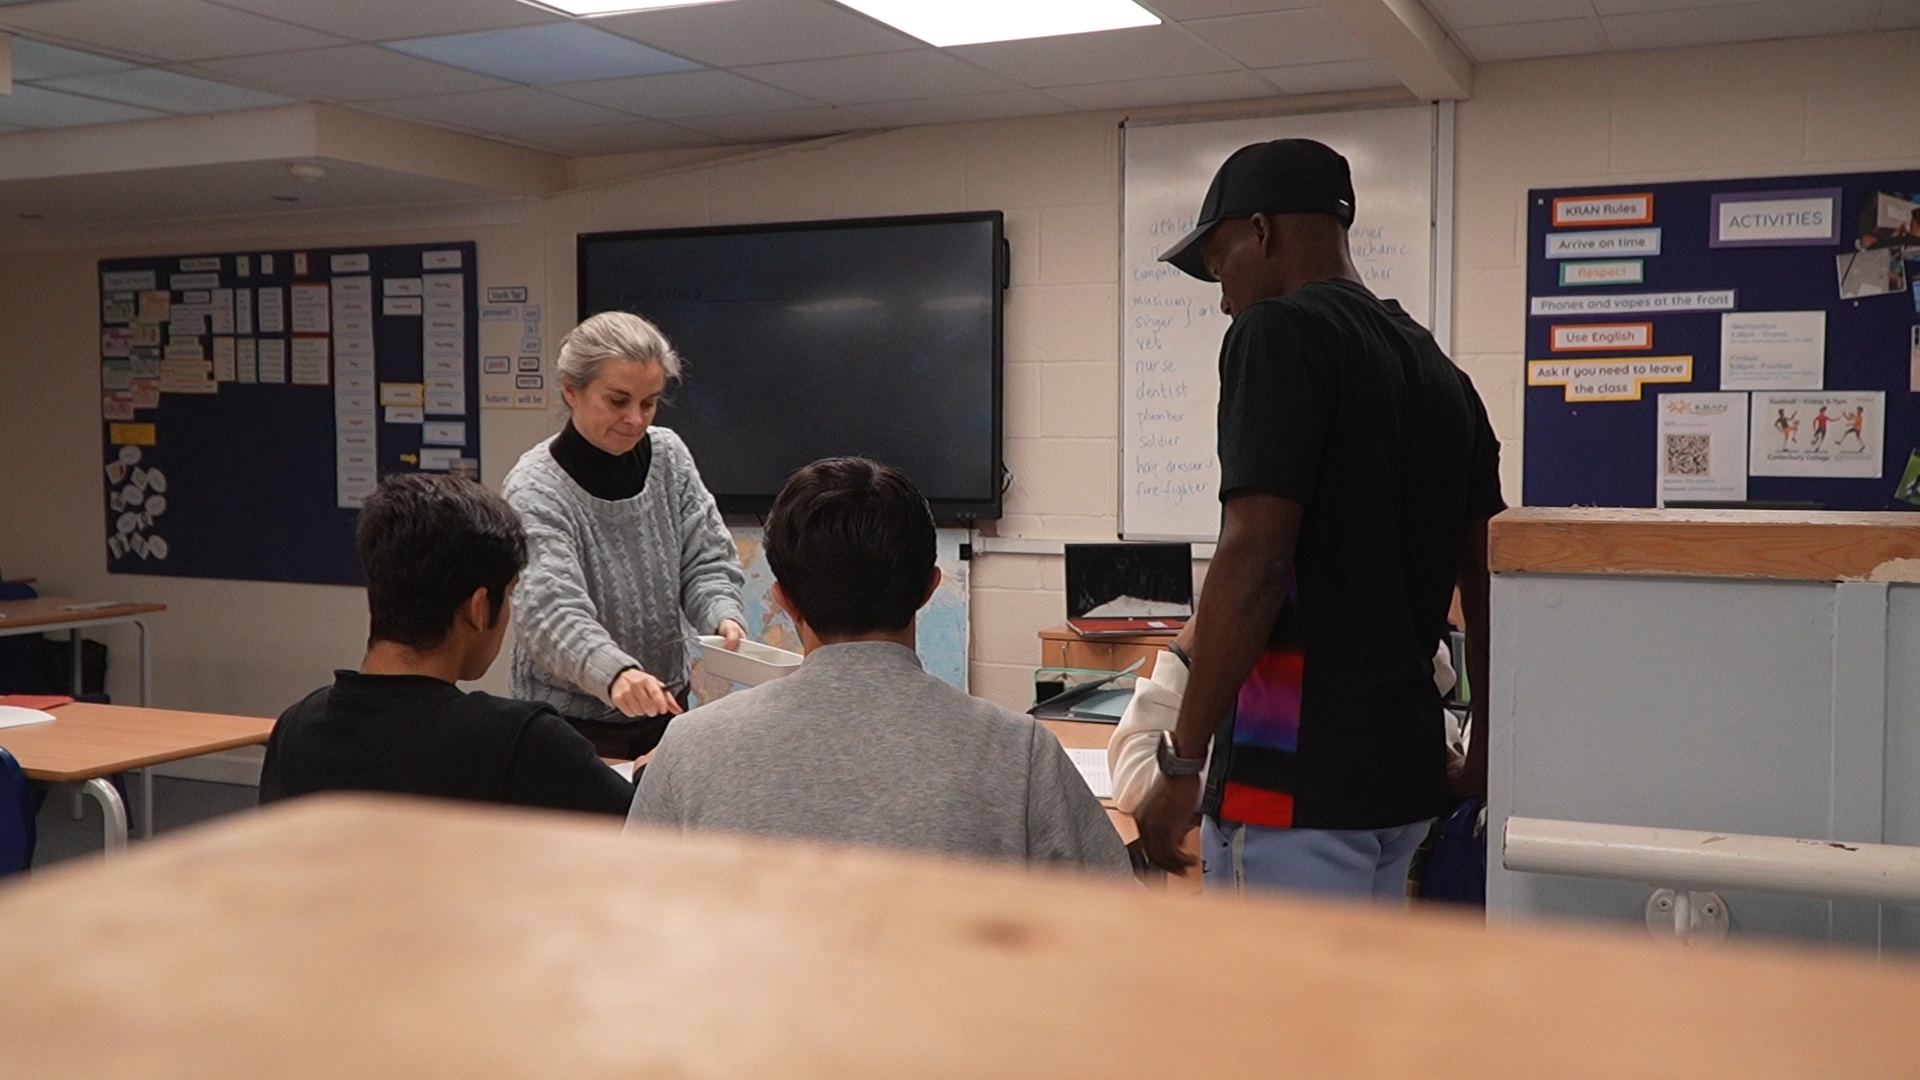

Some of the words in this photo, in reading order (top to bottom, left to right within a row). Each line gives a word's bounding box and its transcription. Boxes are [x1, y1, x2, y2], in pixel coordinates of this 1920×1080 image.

[1565, 204, 1600, 216] KRAN
[1603, 203, 1637, 214] Rules
[1149, 216, 1194, 236] athlet
[1728, 211, 1823, 228] ACTIVITIES
[1558, 239, 1595, 250] Arrive
[1598, 239, 1614, 248] on
[1618, 236, 1646, 247] time
[1577, 266, 1627, 281] Respect
[1540, 300, 1584, 311] Phones
[1587, 299, 1611, 309] and
[1614, 299, 1650, 312] vapes
[1654, 296, 1669, 306] at
[1672, 294, 1692, 305] the
[1694, 294, 1729, 305] front
[1134, 316, 1175, 333] singer
[1566, 333, 1588, 343] Use
[1592, 331, 1635, 346] English
[1135, 359, 1176, 374] nurse
[1537, 366, 1558, 377] Ask
[1561, 366, 1570, 376] if
[1573, 367, 1596, 379] you
[1599, 365, 1629, 376] need
[1633, 365, 1647, 375] to
[1650, 363, 1684, 374] leave
[1136, 381, 1189, 400] dentist
[1574, 383, 1594, 394] the
[1597, 382, 1628, 393] class
[1136, 408, 1185, 430] plumber
[1139, 434, 1181, 449] soldier
